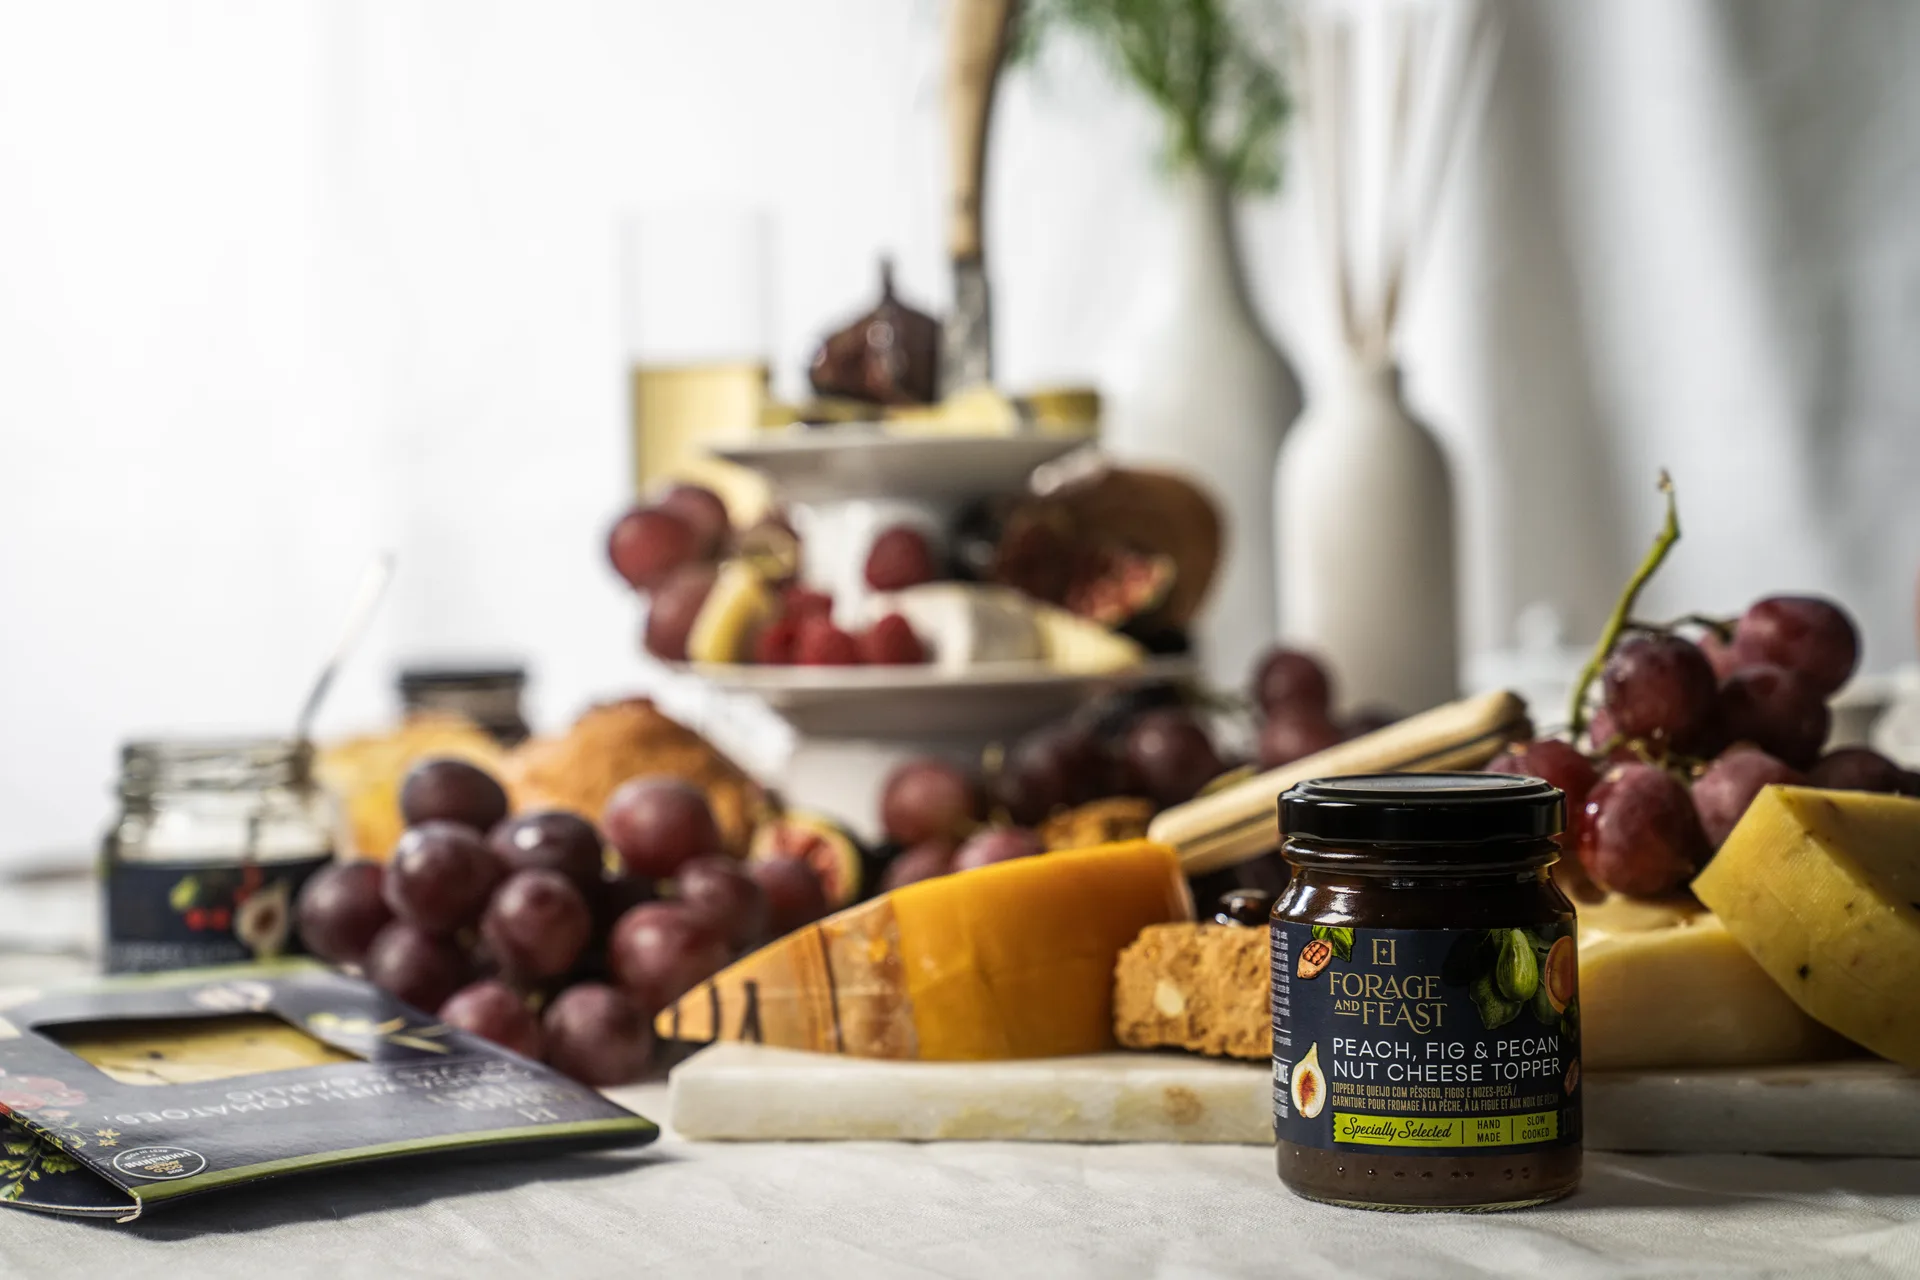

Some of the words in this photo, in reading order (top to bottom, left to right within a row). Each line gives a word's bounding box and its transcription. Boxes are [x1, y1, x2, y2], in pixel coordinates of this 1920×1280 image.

[1329, 971, 1442, 1000] FORAGE
[1334, 999, 1360, 1012] AND
[1362, 1000, 1448, 1034] FEAST
[1333, 1037, 1417, 1062] PEACH,
[1426, 1042, 1465, 1060] FIG
[1474, 1041, 1489, 1059] &
[1497, 1035, 1559, 1058] PECAN
[1333, 1060, 1379, 1079] NUT
[1387, 1063, 1483, 1082] CHEESE
[1490, 1057, 1561, 1081] TOPPER
[1332, 1081, 1355, 1095] TOPPER
[1356, 1084, 1365, 1096] DE
[1366, 1085, 1391, 1098] QUEIJO
[1392, 1086, 1408, 1098] COM
[1409, 1085, 1443, 1099] PÊSSEGO,
[1444, 1087, 1465, 1099] FIGOS
[1466, 1087, 1471, 1098] E
[1332, 1095, 1367, 1109] GARNITURE
[1368, 1098, 1386, 1110] POUR
[1387, 1099, 1420, 1111] FROMAGE
[1421, 1098, 1427, 1112] À
[1428, 1100, 1437, 1112] LA
[1439, 1098, 1463, 1112] PÊCHE,
[1464, 1098, 1470, 1112] À
[1471, 1100, 1479, 1111] LA
[1481, 1099, 1500, 1111] FIGUE
[1501, 1099, 1508, 1110] ET
[1509, 1098, 1521, 1109] AUX
[1477, 1119, 1501, 1130] HAND
[1526, 1115, 1546, 1126] SLOW
[1342, 1117, 1397, 1142] Specially
[1397, 1120, 1453, 1139] Selected
[1477, 1132, 1501, 1143] MADE
[1522, 1127, 1550, 1140] COOKED
